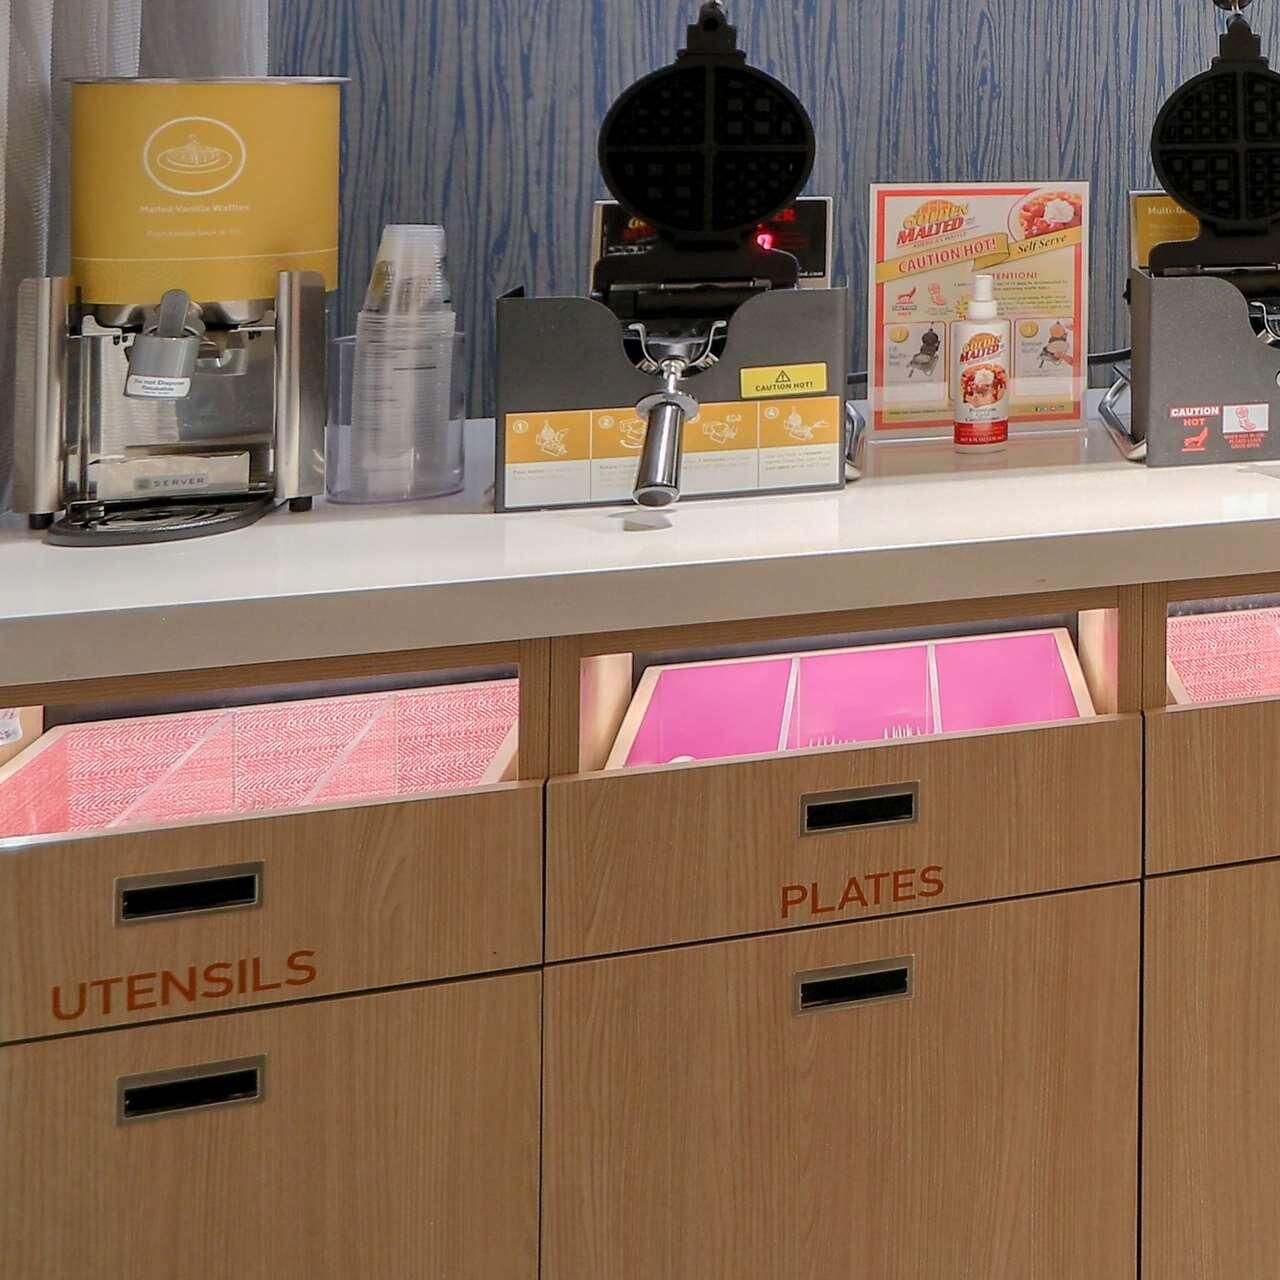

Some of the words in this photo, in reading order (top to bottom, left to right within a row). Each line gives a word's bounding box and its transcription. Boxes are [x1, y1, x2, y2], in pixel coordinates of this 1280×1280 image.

[897, 216, 965, 245] MALTED
[1017, 241, 1036, 254] Self
[1037, 234, 1067, 250] Serve
[898, 247, 960, 273] CAUTION
[964, 238, 996, 257] HOT!
[755, 381, 791, 393] CAUTION
[793, 380, 814, 390] HOT!
[1170, 406, 1220, 417] CAUTION
[1183, 418, 1206, 426] HOT
[153, 477, 205, 487] SERVER
[780, 865, 945, 919] PLATES
[51, 949, 320, 1021] UTENSILS
